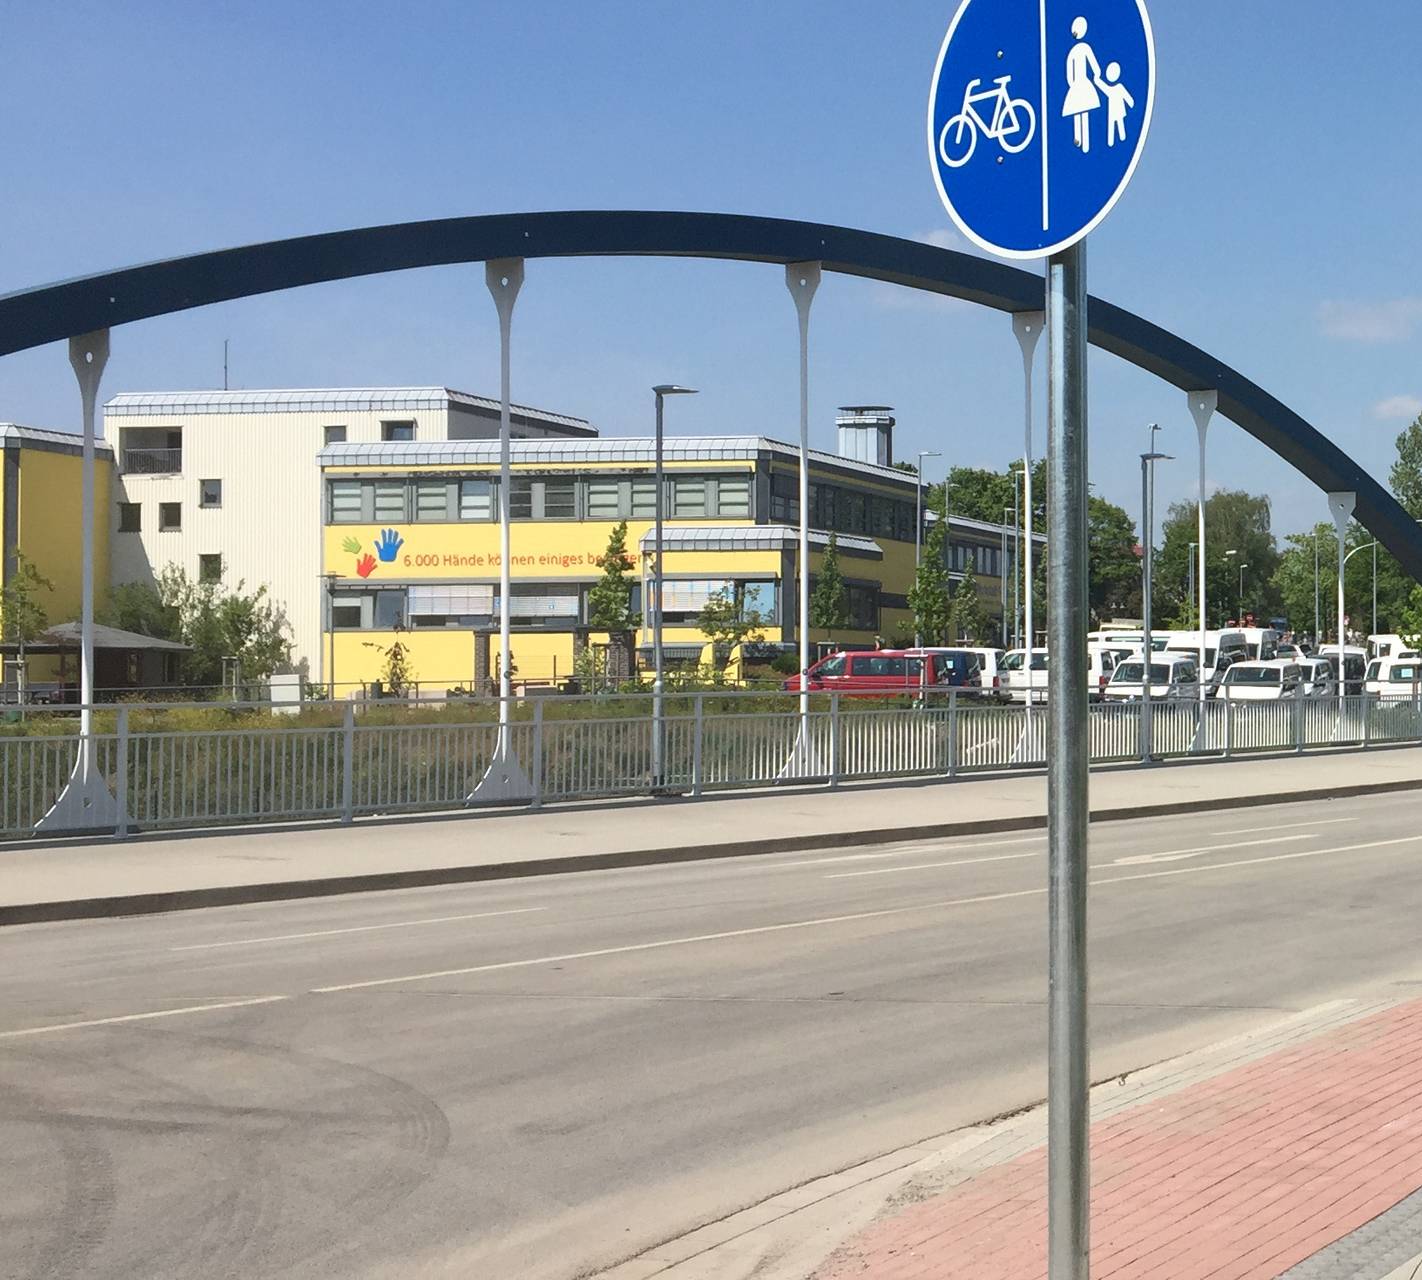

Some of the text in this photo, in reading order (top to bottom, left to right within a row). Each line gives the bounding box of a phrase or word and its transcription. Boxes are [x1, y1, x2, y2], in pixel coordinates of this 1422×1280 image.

[403, 554, 439, 567] 6.000
[443, 554, 484, 566] Hände
[488, 553, 535, 566] könen
[539, 553, 584, 568] einiges
